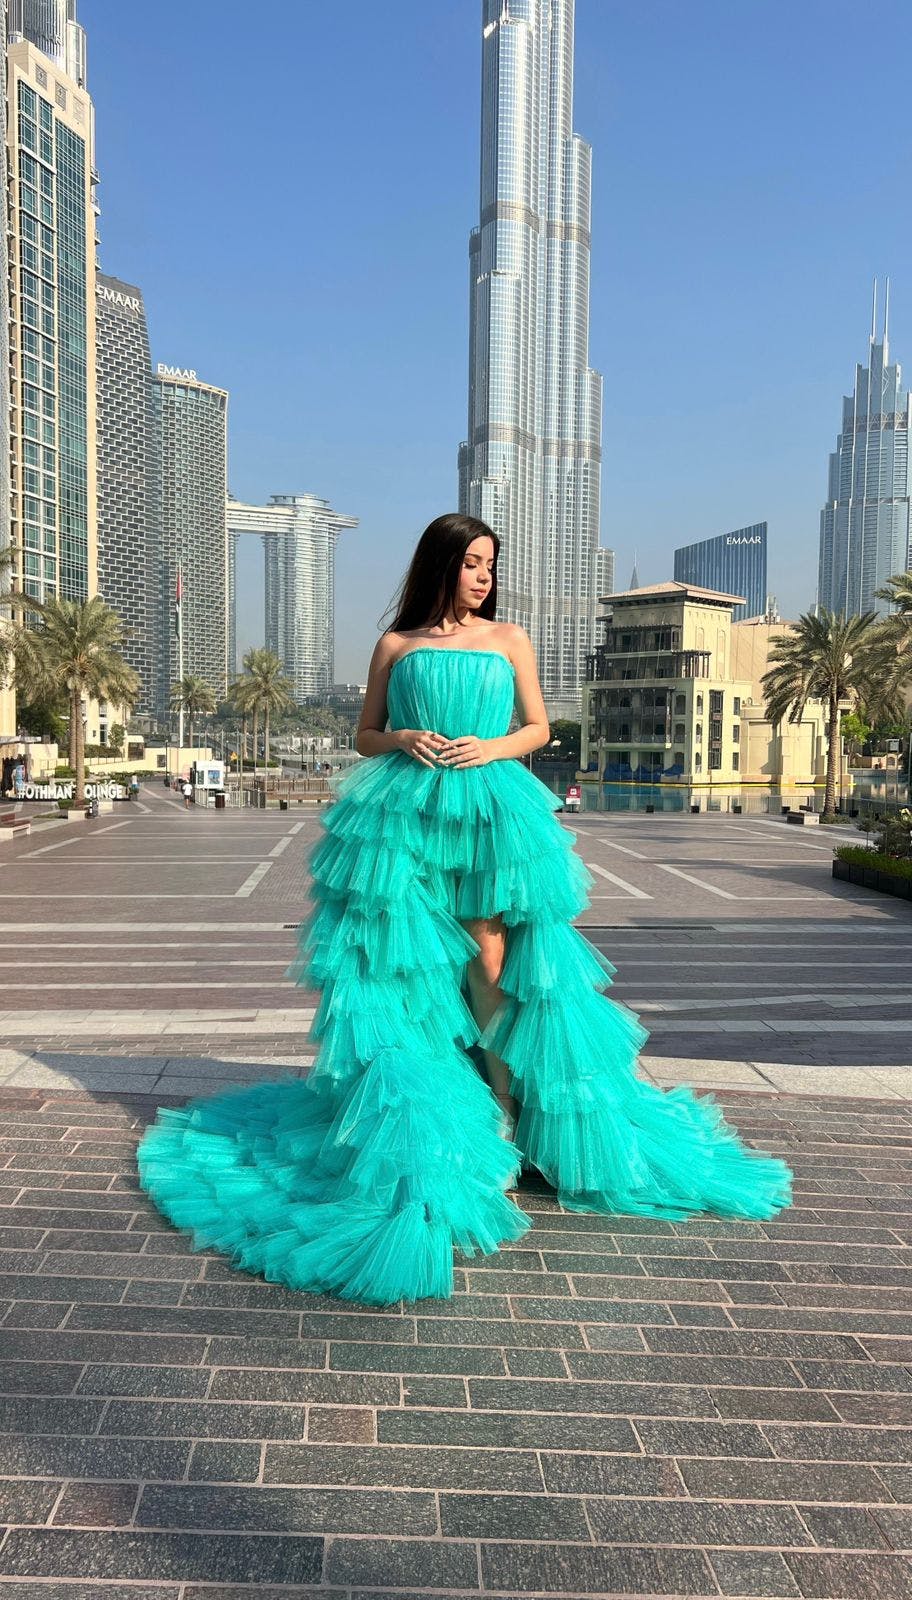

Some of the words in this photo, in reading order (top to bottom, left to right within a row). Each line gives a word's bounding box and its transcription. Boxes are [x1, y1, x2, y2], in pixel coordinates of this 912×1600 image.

[157, 362, 198, 381] EMAAR
[726, 535, 762, 545] EMAAR
[84, 783, 123, 799] OUNGE
